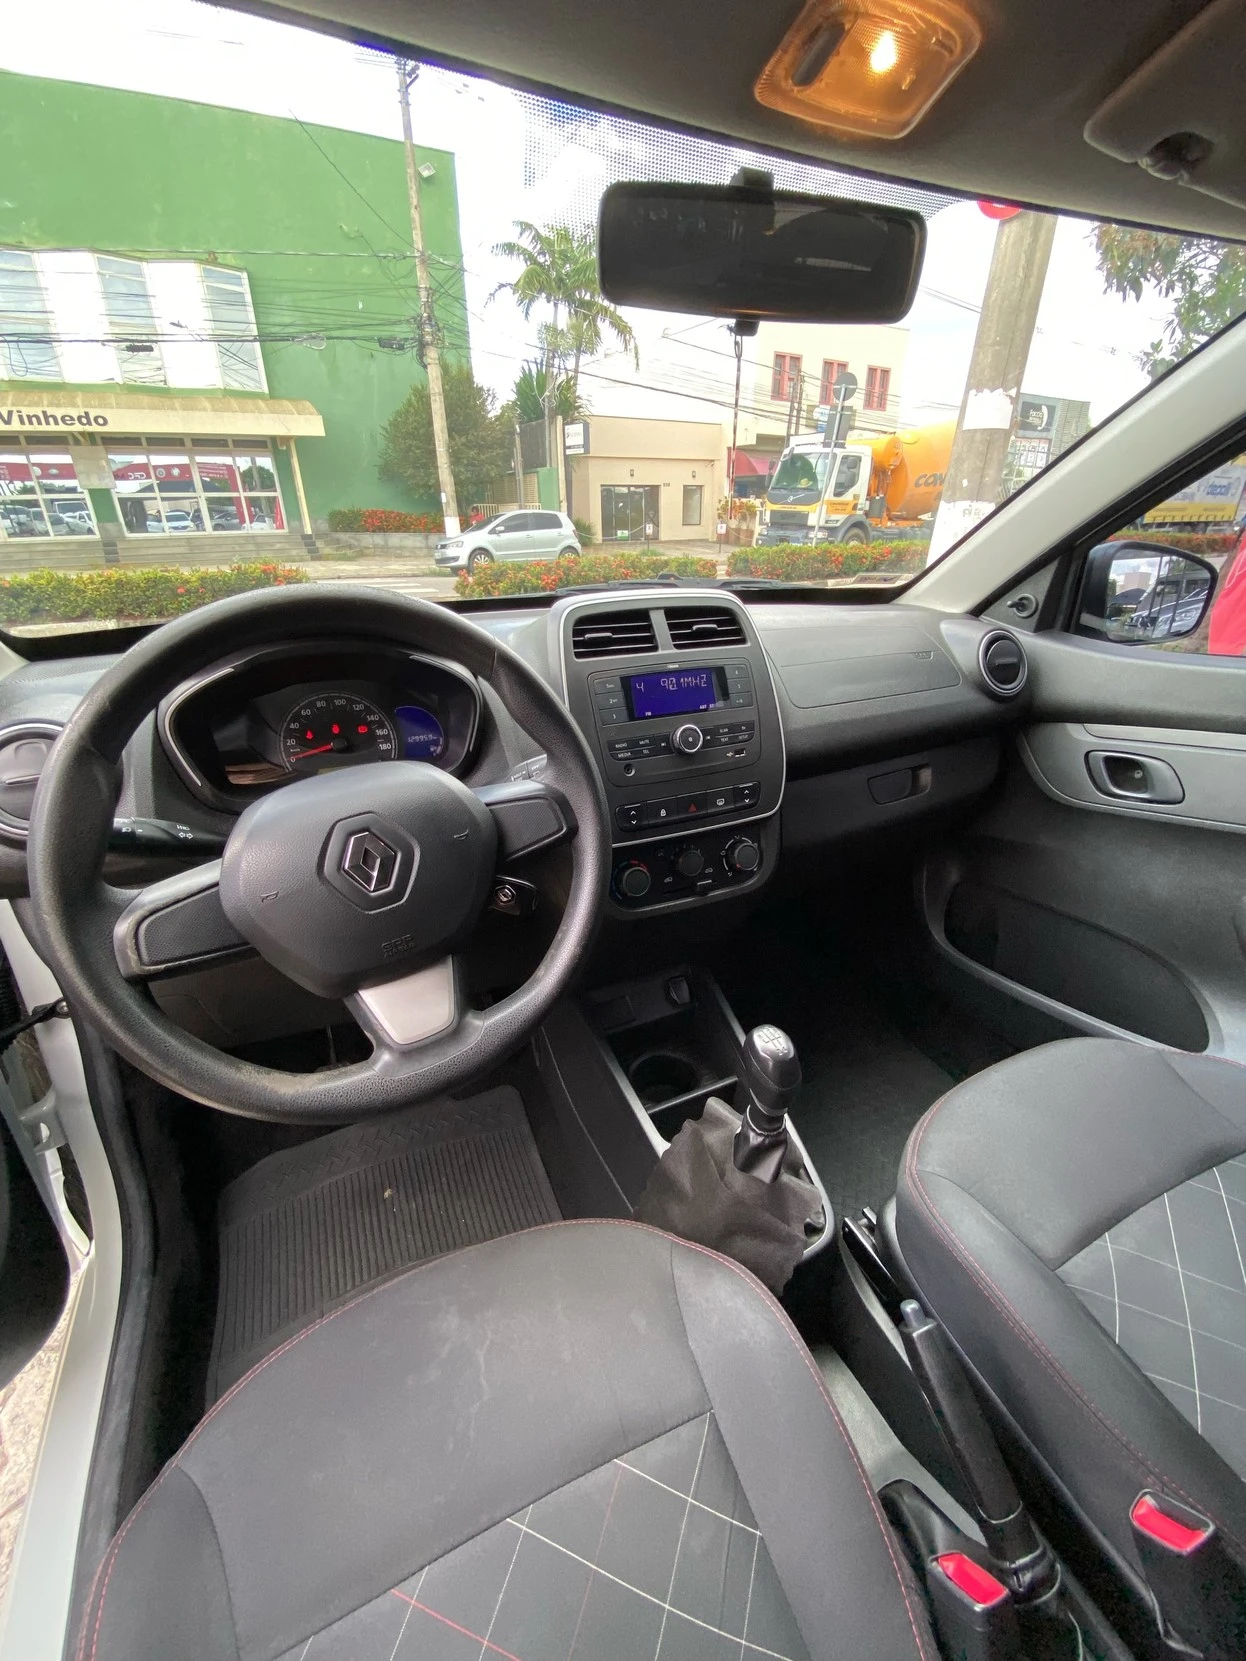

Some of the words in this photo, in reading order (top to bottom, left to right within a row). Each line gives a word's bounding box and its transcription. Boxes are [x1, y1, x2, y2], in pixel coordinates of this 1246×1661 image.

[0, 410, 108, 427] Vinhedo
[316, 700, 326, 708] 80
[352, 703, 365, 711] 120
[301, 708, 311, 716] 60
[366, 714, 380, 722] 140
[286, 738, 296, 746] 20
